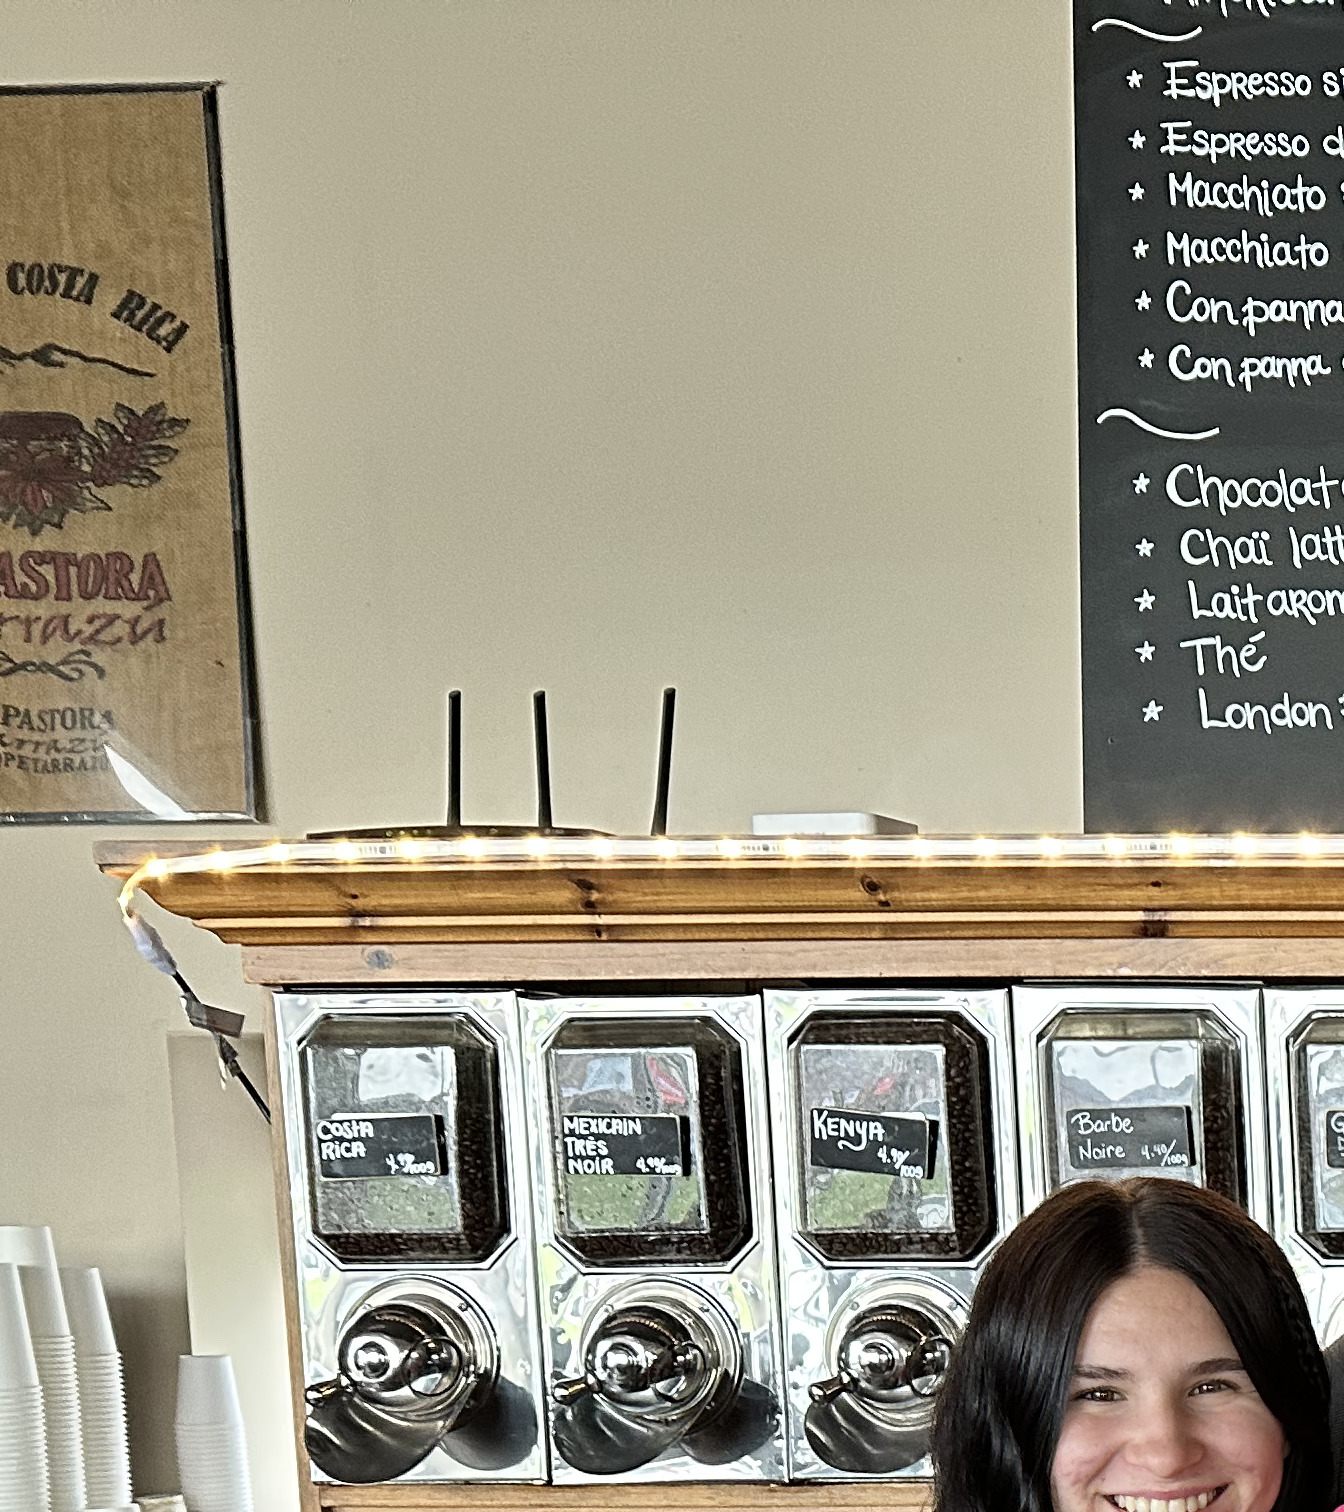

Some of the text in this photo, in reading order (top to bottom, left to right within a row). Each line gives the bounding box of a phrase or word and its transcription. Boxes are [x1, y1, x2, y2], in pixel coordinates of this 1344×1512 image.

[1168, 171, 1327, 215] Macchiato
[1167, 229, 1330, 271] Macchiato
[6, 261, 190, 354] COSTA RICA
[1165, 279, 1237, 325] Con
[1168, 343, 1236, 388] Con
[1239, 347, 1332, 393] panna
[1165, 462, 1340, 516] Chocolat
[1180, 524, 1270, 571] Chaï
[1188, 578, 1263, 623] Lait
[1180, 631, 1267, 677] Thé
[1197, 686, 1333, 736] London
[563, 1116, 642, 1136] MEXICAIN
[1070, 1111, 1134, 1135] Barbe
[1078, 1138, 1126, 1161] Noire
